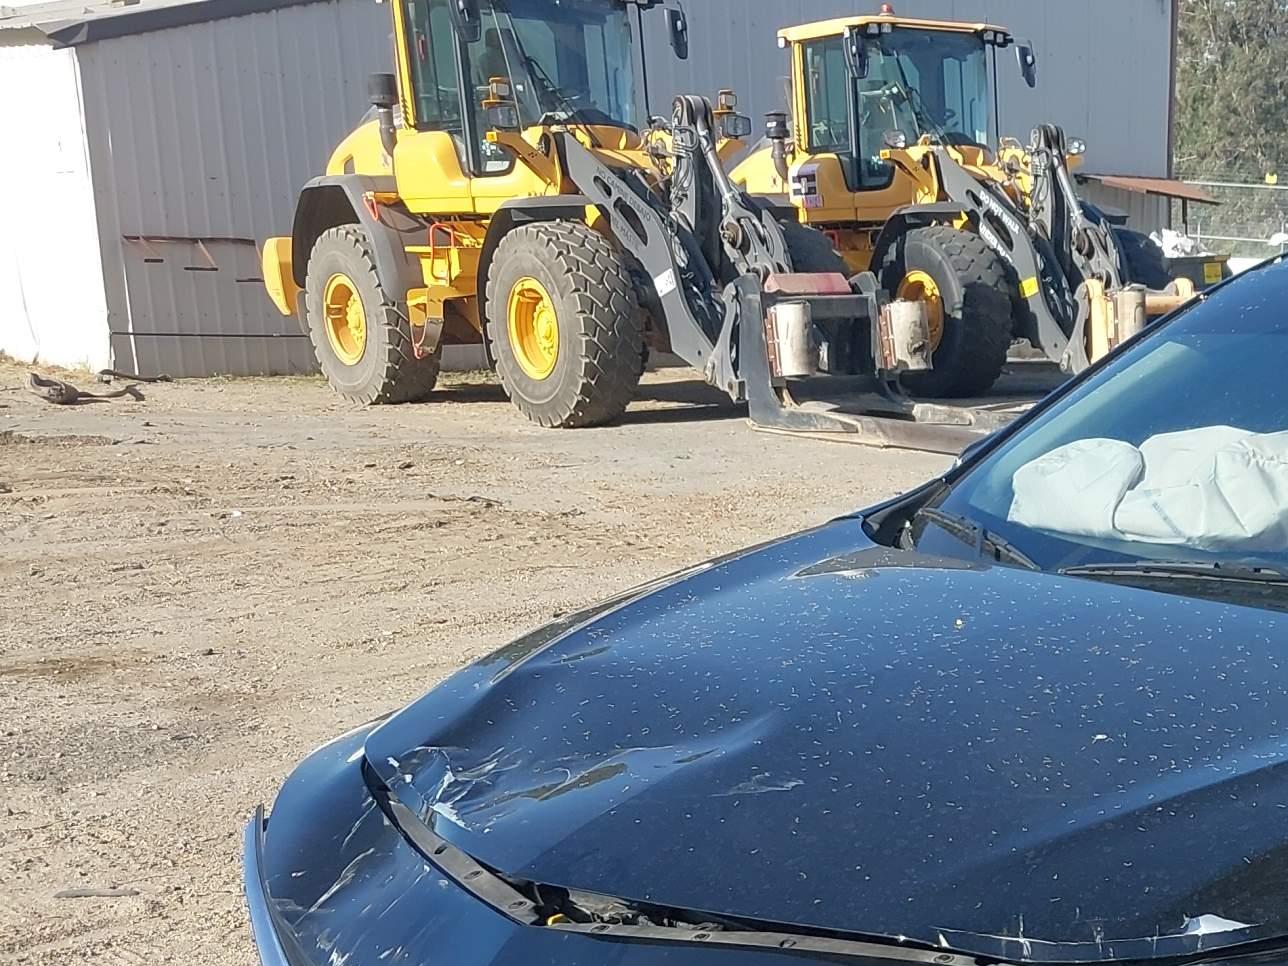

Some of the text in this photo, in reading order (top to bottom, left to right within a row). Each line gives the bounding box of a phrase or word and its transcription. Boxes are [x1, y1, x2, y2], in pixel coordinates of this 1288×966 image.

[980, 190, 1020, 234] DO NOT WALK
